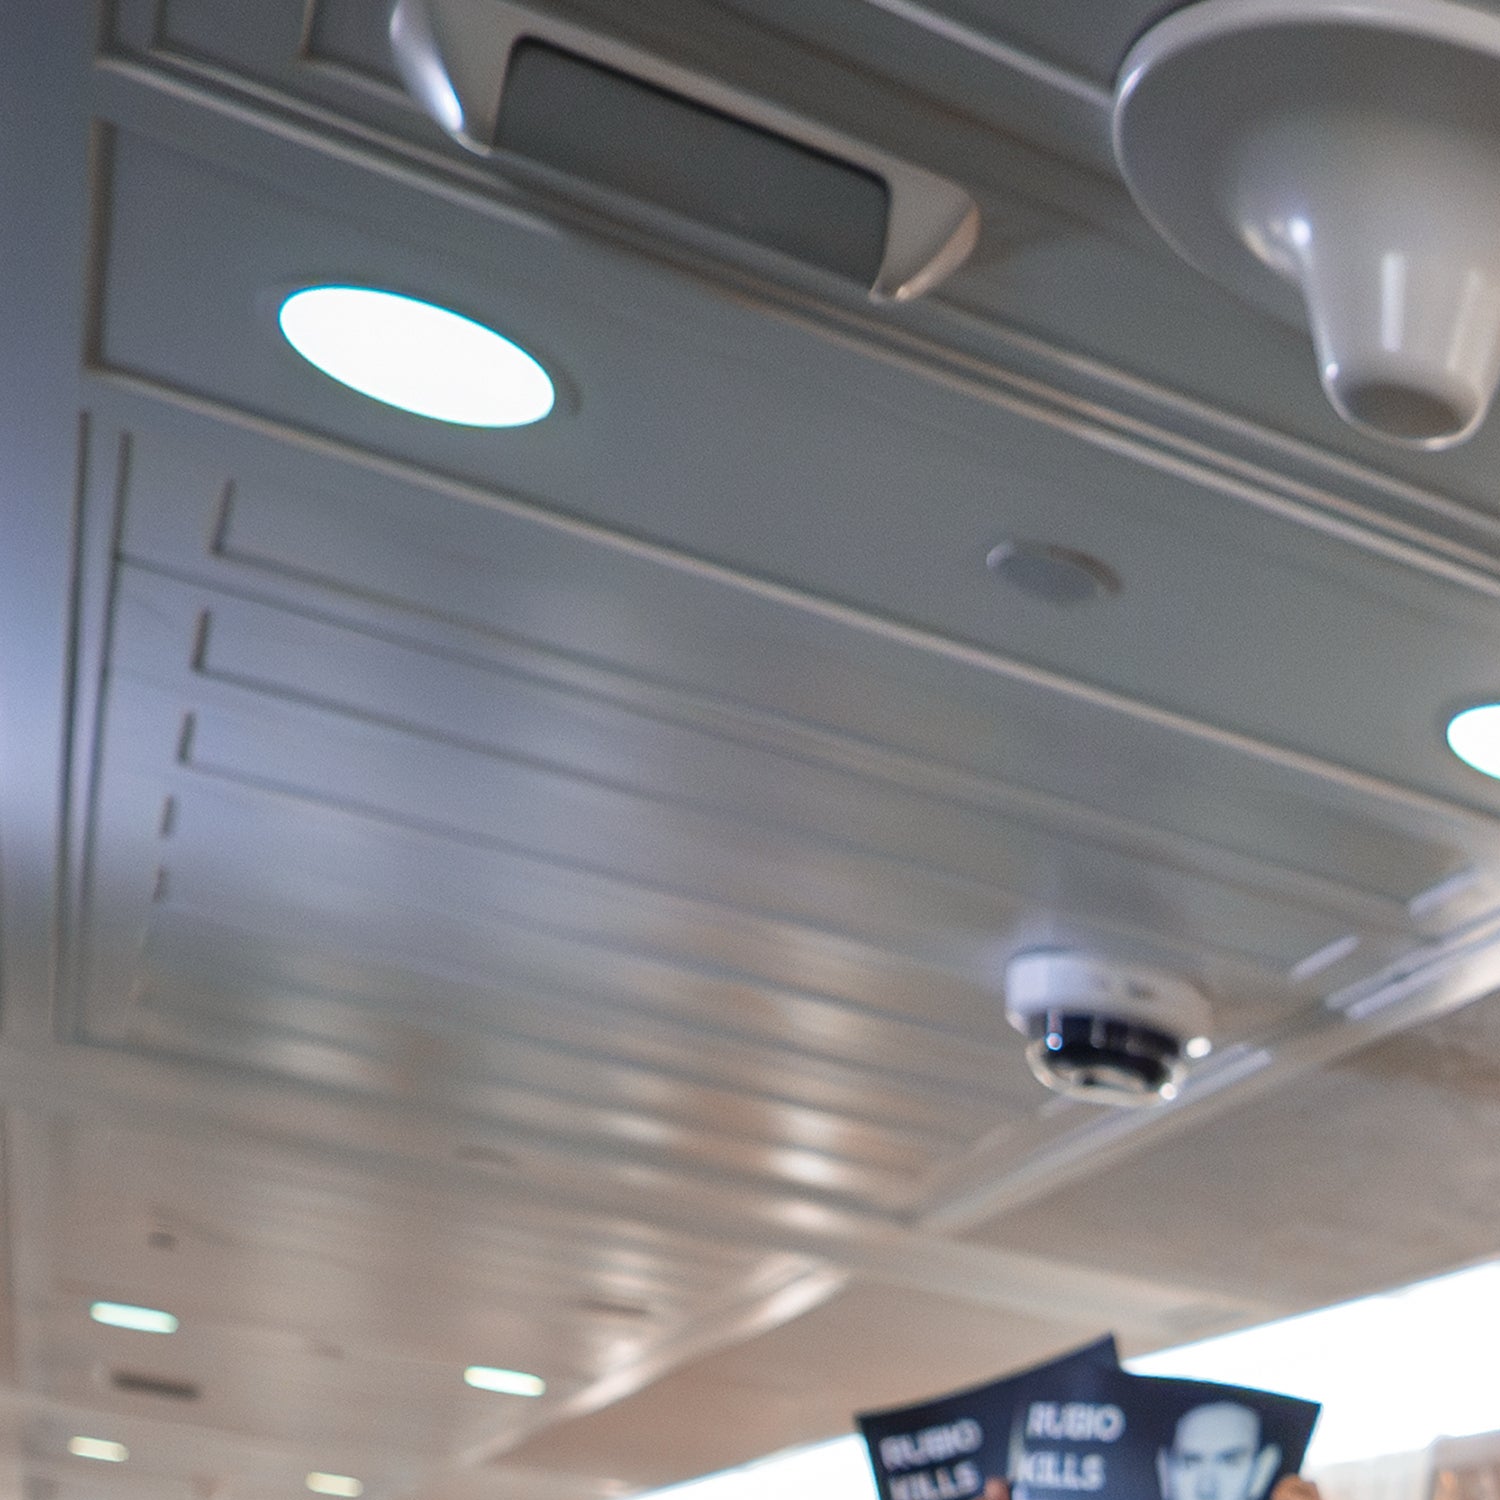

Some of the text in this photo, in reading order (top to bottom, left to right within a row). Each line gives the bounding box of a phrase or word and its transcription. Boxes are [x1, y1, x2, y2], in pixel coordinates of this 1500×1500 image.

[1026, 1402, 1127, 1443] RUBIO
[879, 1418, 984, 1473] RUBIO
[1014, 1451, 1106, 1491] KILLS
